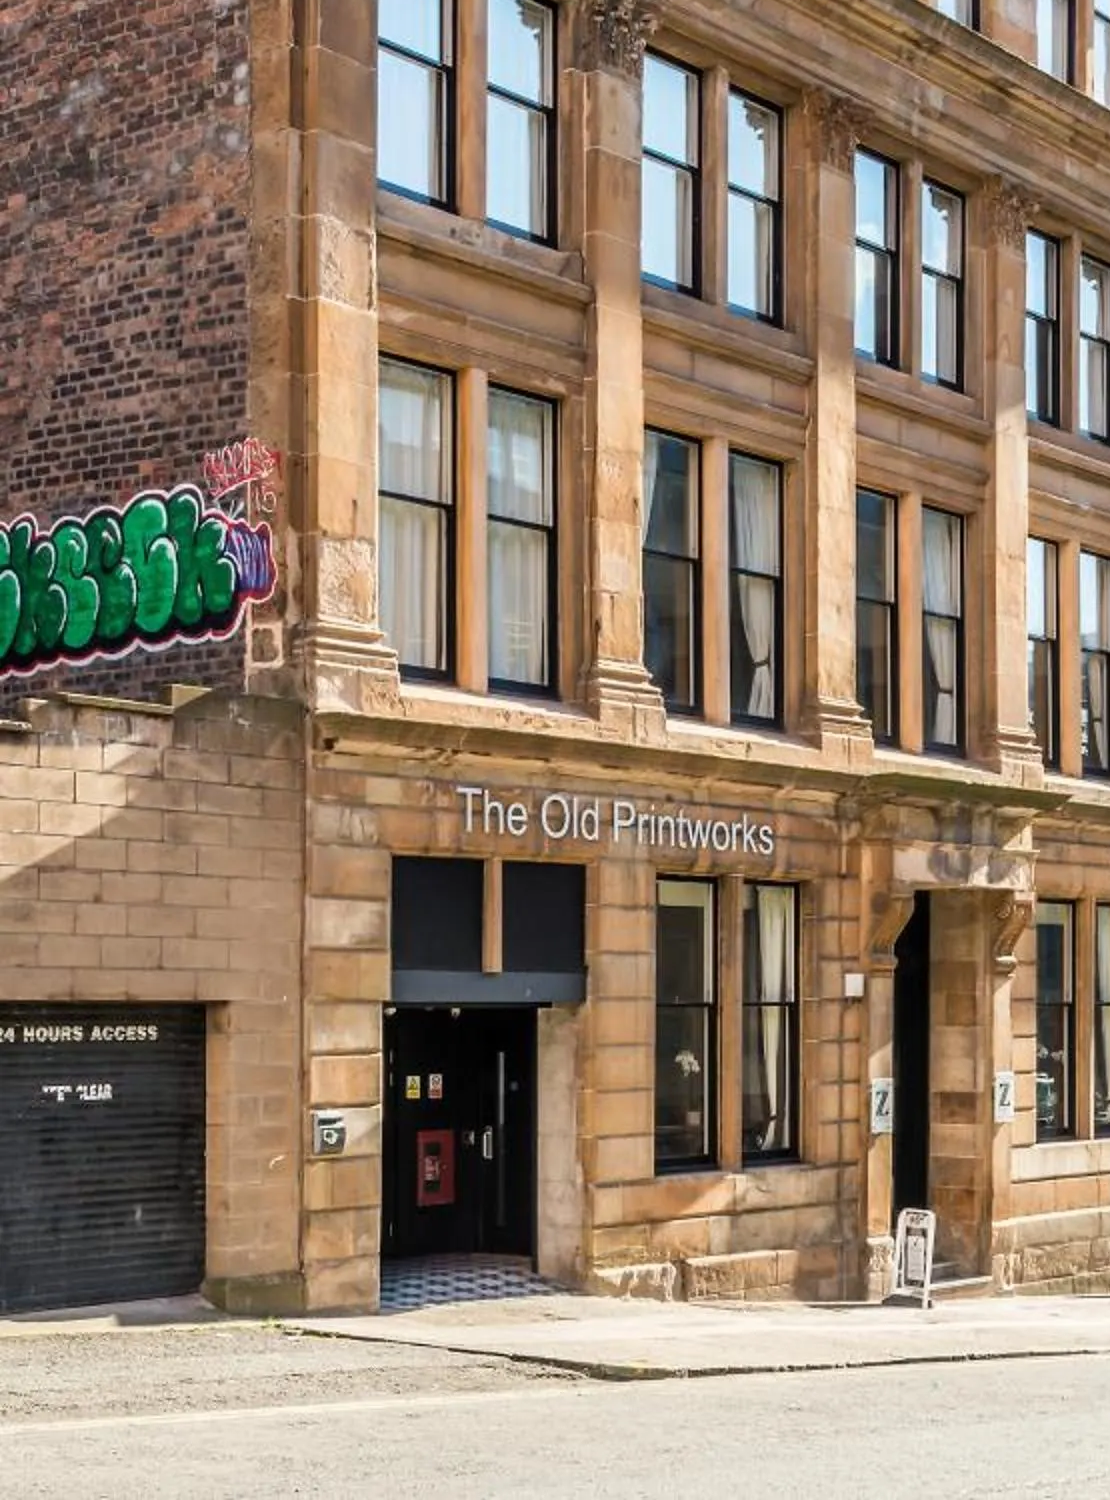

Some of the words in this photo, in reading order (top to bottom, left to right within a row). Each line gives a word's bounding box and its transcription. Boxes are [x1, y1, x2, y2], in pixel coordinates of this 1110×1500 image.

[455, 785, 527, 836] The
[541, 793, 599, 841] Old
[613, 801, 774, 855] Printworks
[23, 1025, 83, 1043] HOURS
[90, 1025, 158, 1041] ACCESS
[1000, 1083, 1011, 1107] Z
